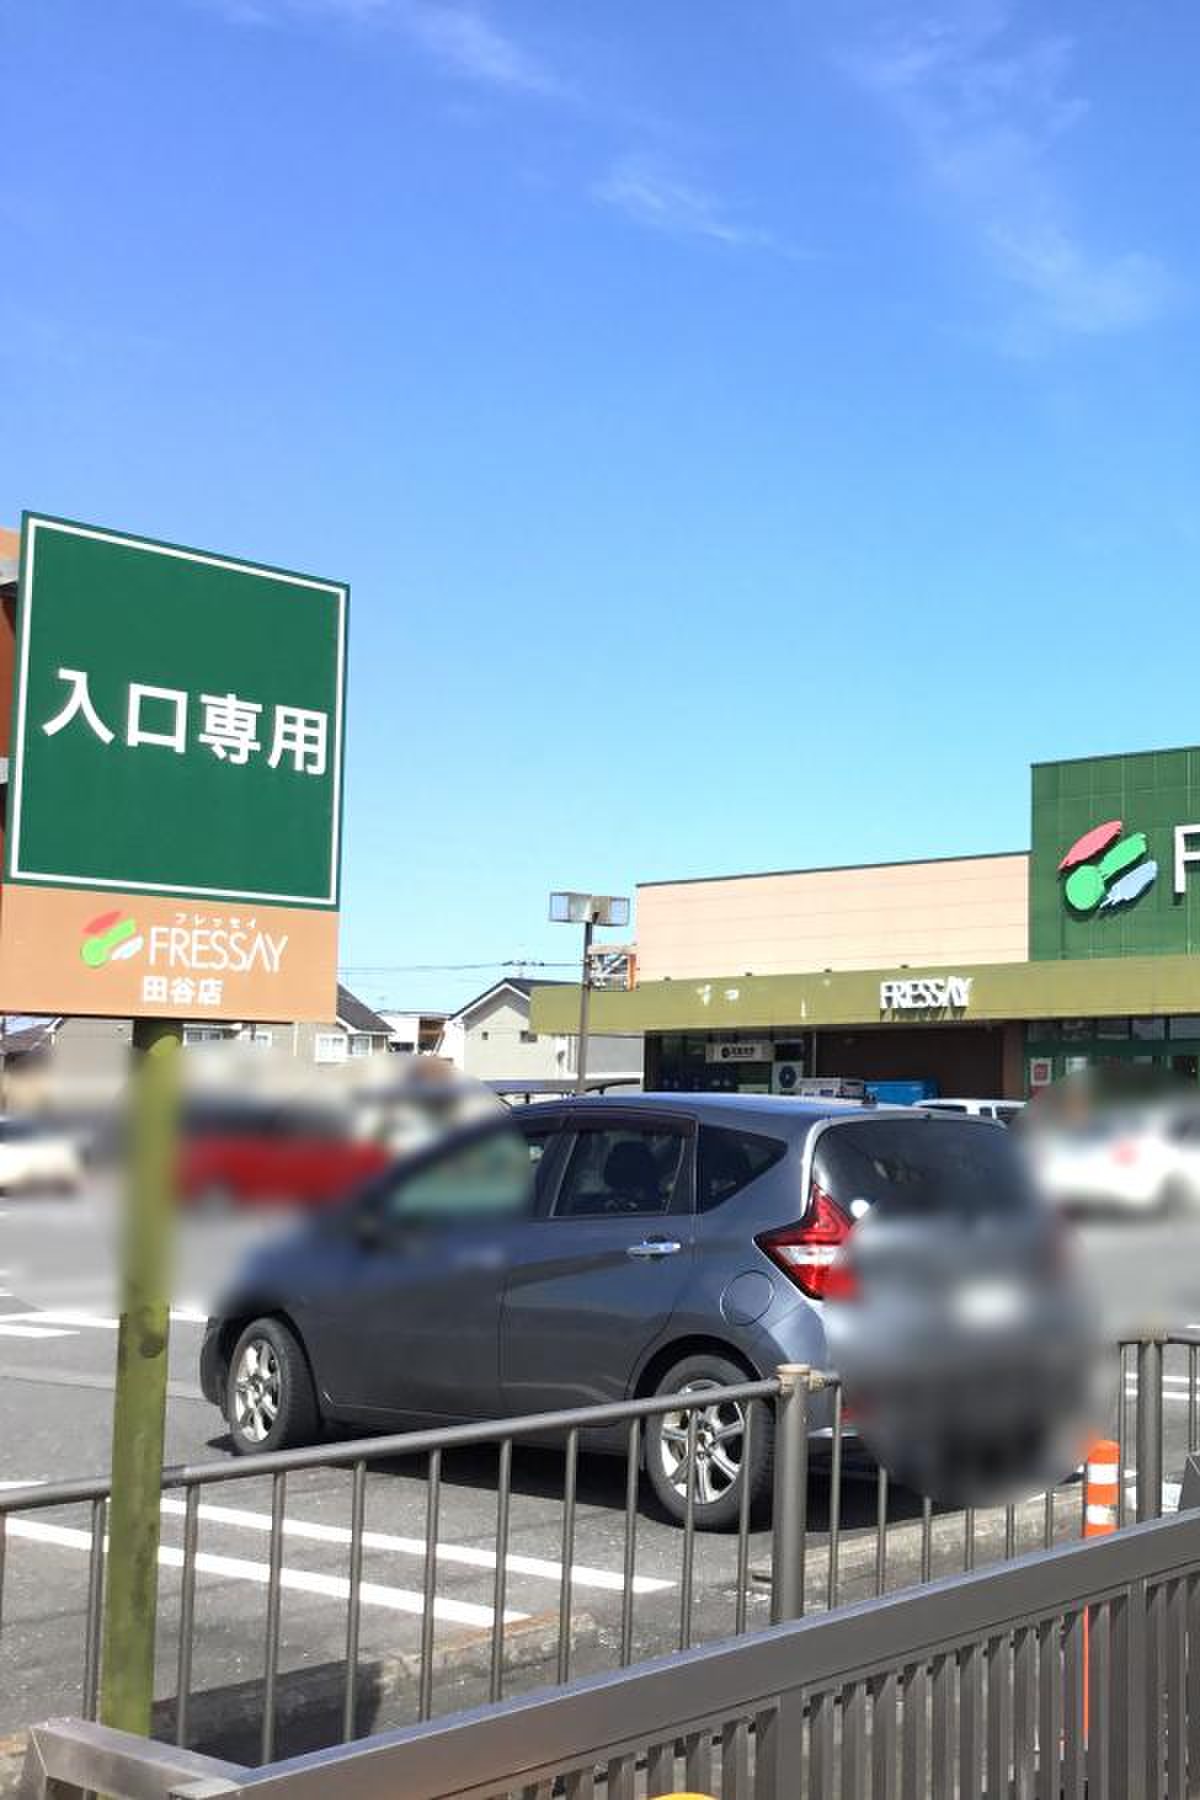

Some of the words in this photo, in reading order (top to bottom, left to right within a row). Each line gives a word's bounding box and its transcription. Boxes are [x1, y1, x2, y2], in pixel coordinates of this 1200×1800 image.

[42, 667, 328, 775] 入口専用
[149, 926, 289, 973] FRESSAY
[143, 975, 224, 1005] 田谷店
[880, 976, 974, 1008] FRESSAY
